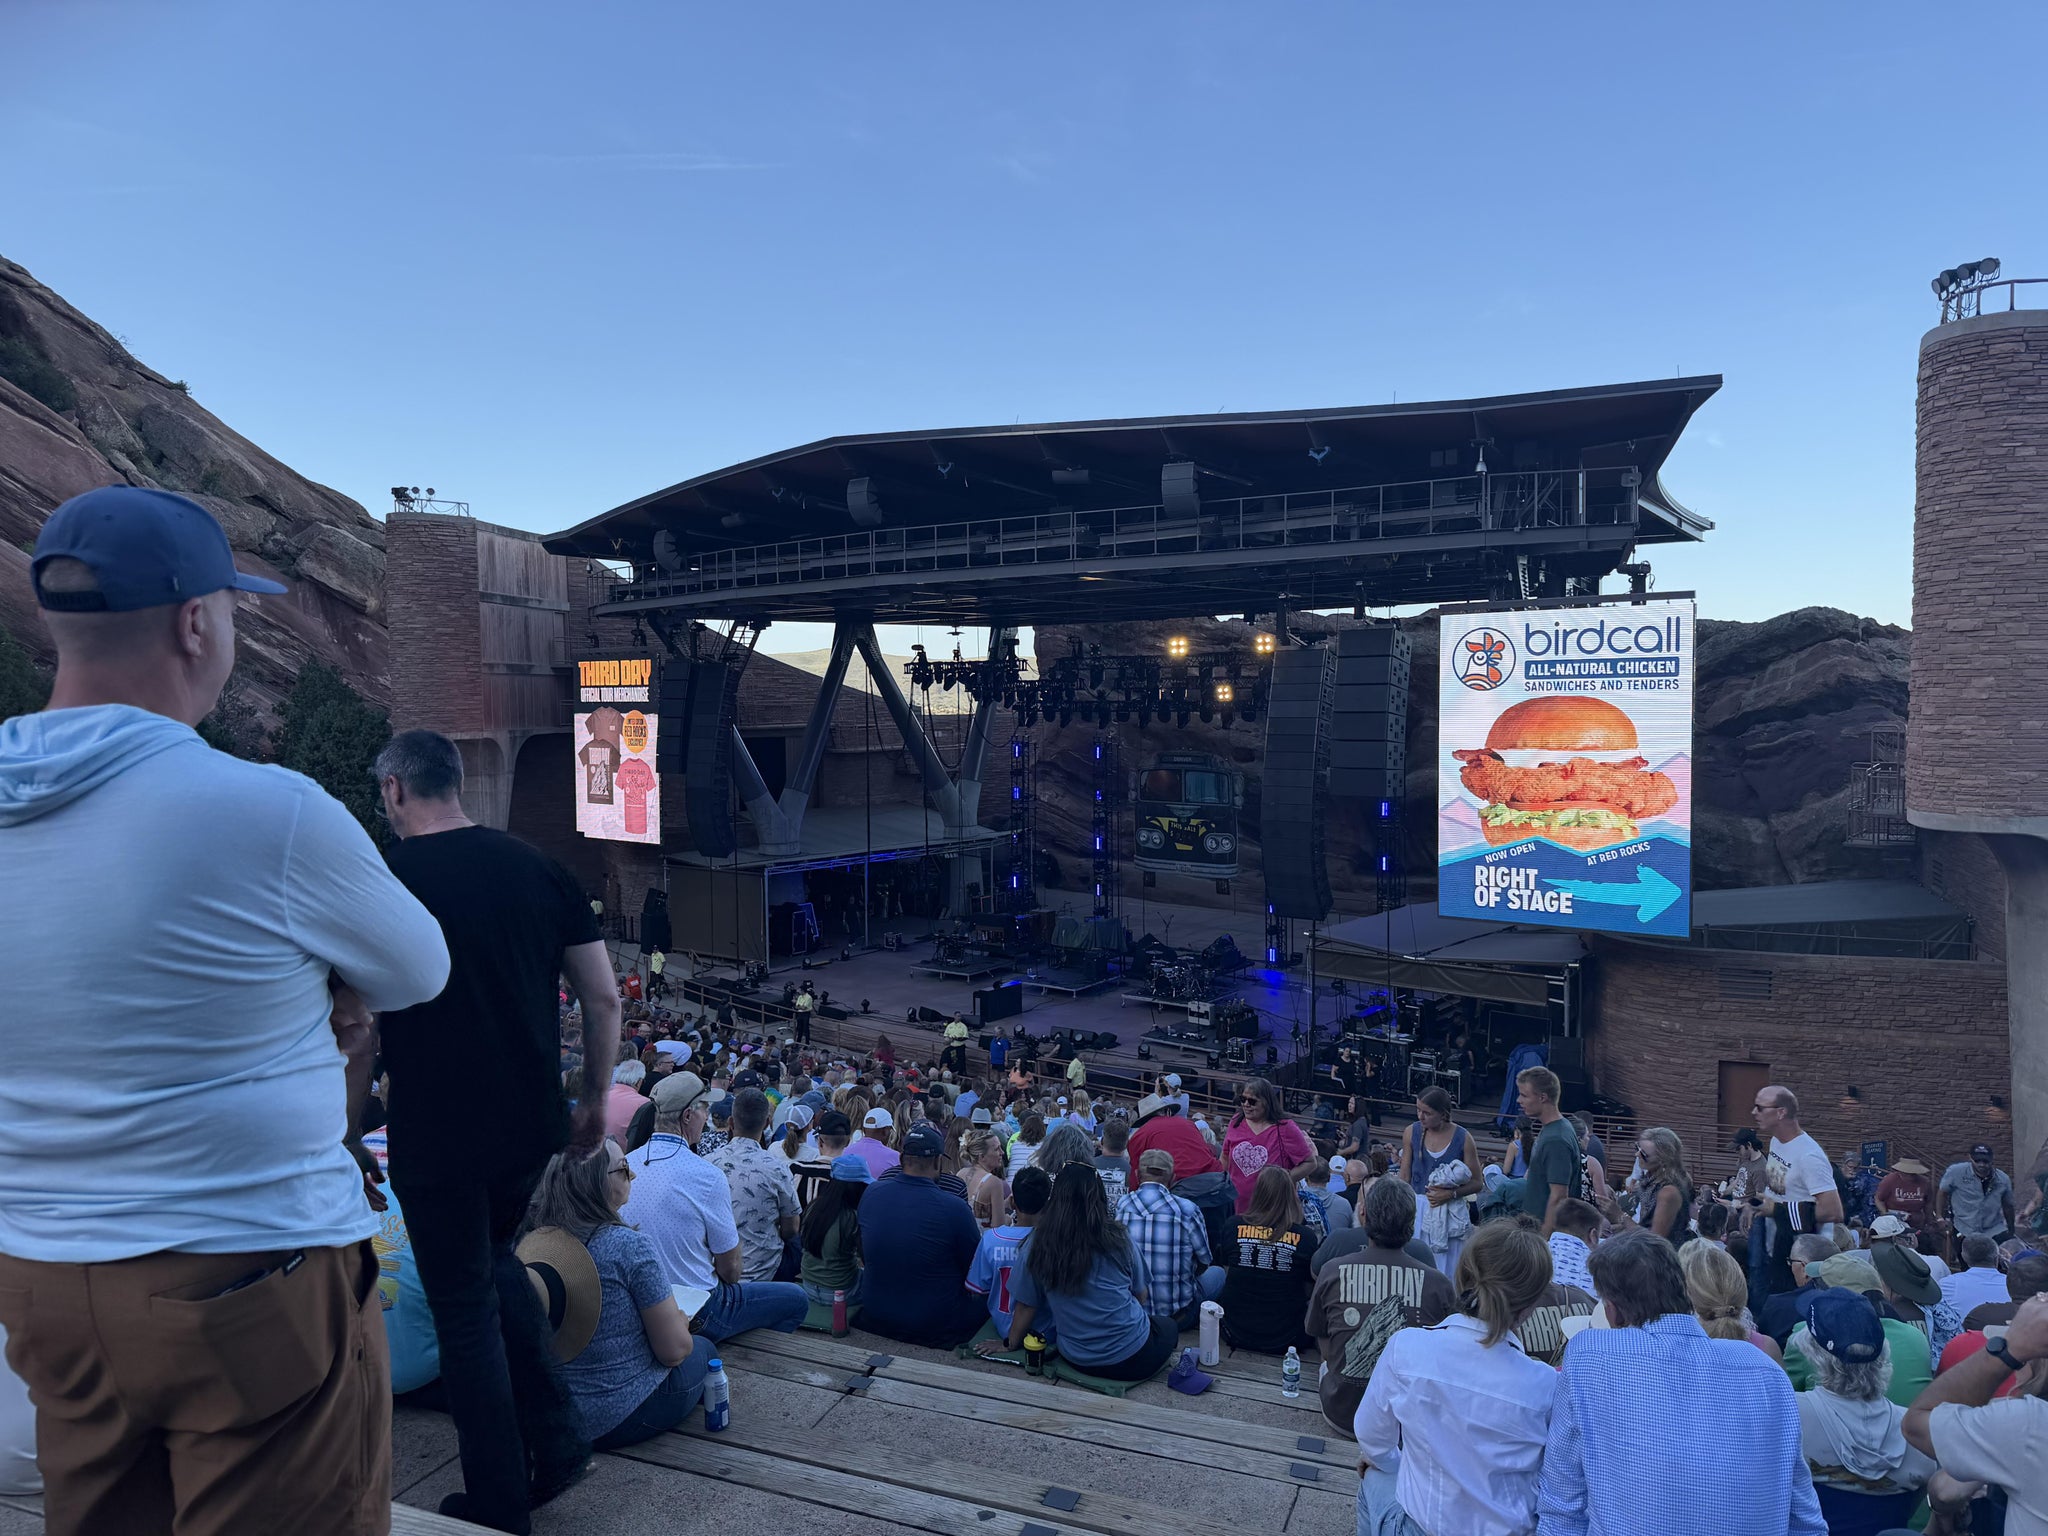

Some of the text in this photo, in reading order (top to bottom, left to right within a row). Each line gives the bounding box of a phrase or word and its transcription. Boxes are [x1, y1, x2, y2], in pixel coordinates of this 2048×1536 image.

[1525, 616, 1681, 656] birdcall
[578, 659, 652, 686] THIRD DAY
[1529, 660, 1676, 677] ALL-NATURAL CHICKEN
[1524, 678, 1680, 692] SANDWICHES AND TENDERS
[1485, 842, 1536, 864] NOW OPEN
[1587, 841, 1651, 867] AT RED ROCKS
[1474, 864, 1539, 890] RIGHT
[1474, 885, 1574, 914] OF STAGE
[1338, 1264, 1425, 1308] THIRD DAY
